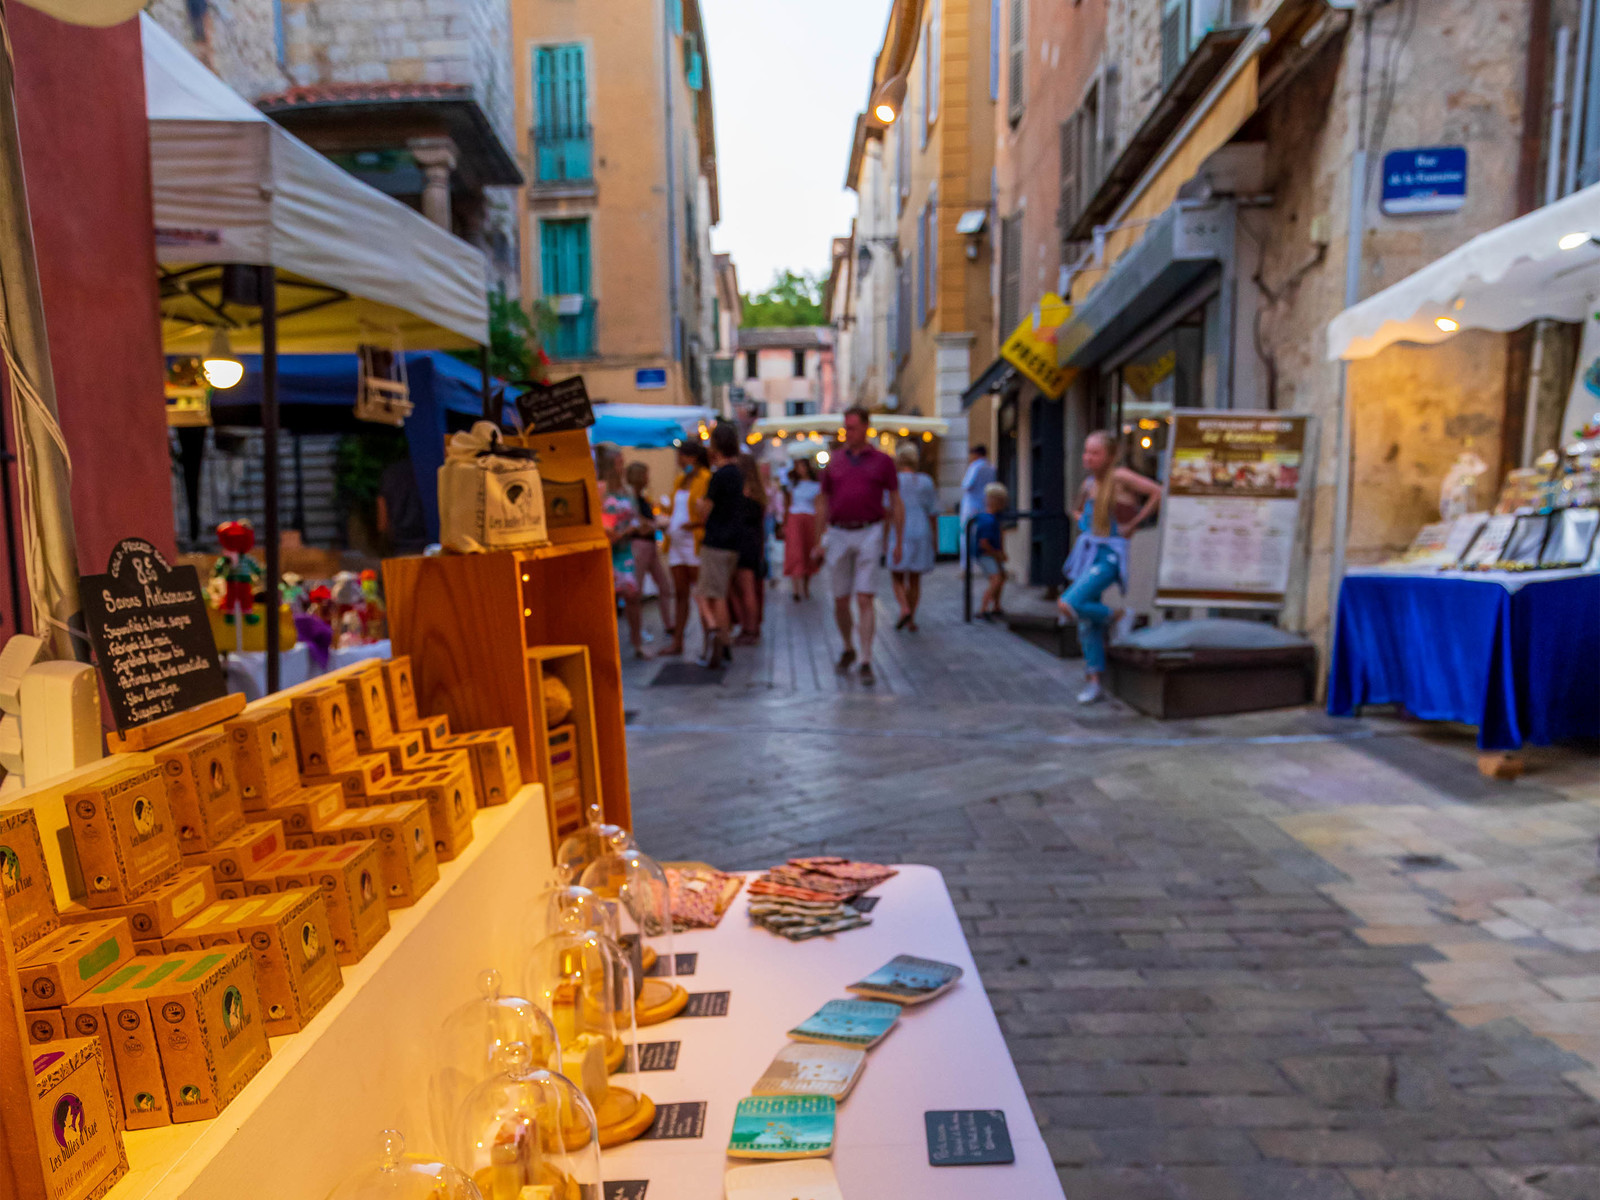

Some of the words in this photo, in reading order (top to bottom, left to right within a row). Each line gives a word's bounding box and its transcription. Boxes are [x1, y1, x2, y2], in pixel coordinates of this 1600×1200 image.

[1010, 339, 1067, 391] PRESSE
[49, 1154, 63, 1173] Les
[53, 1185, 65, 1200] Un
[63, 1174, 75, 1193] été
[74, 1169, 83, 1184] en
[82, 1143, 108, 1175] Provence
